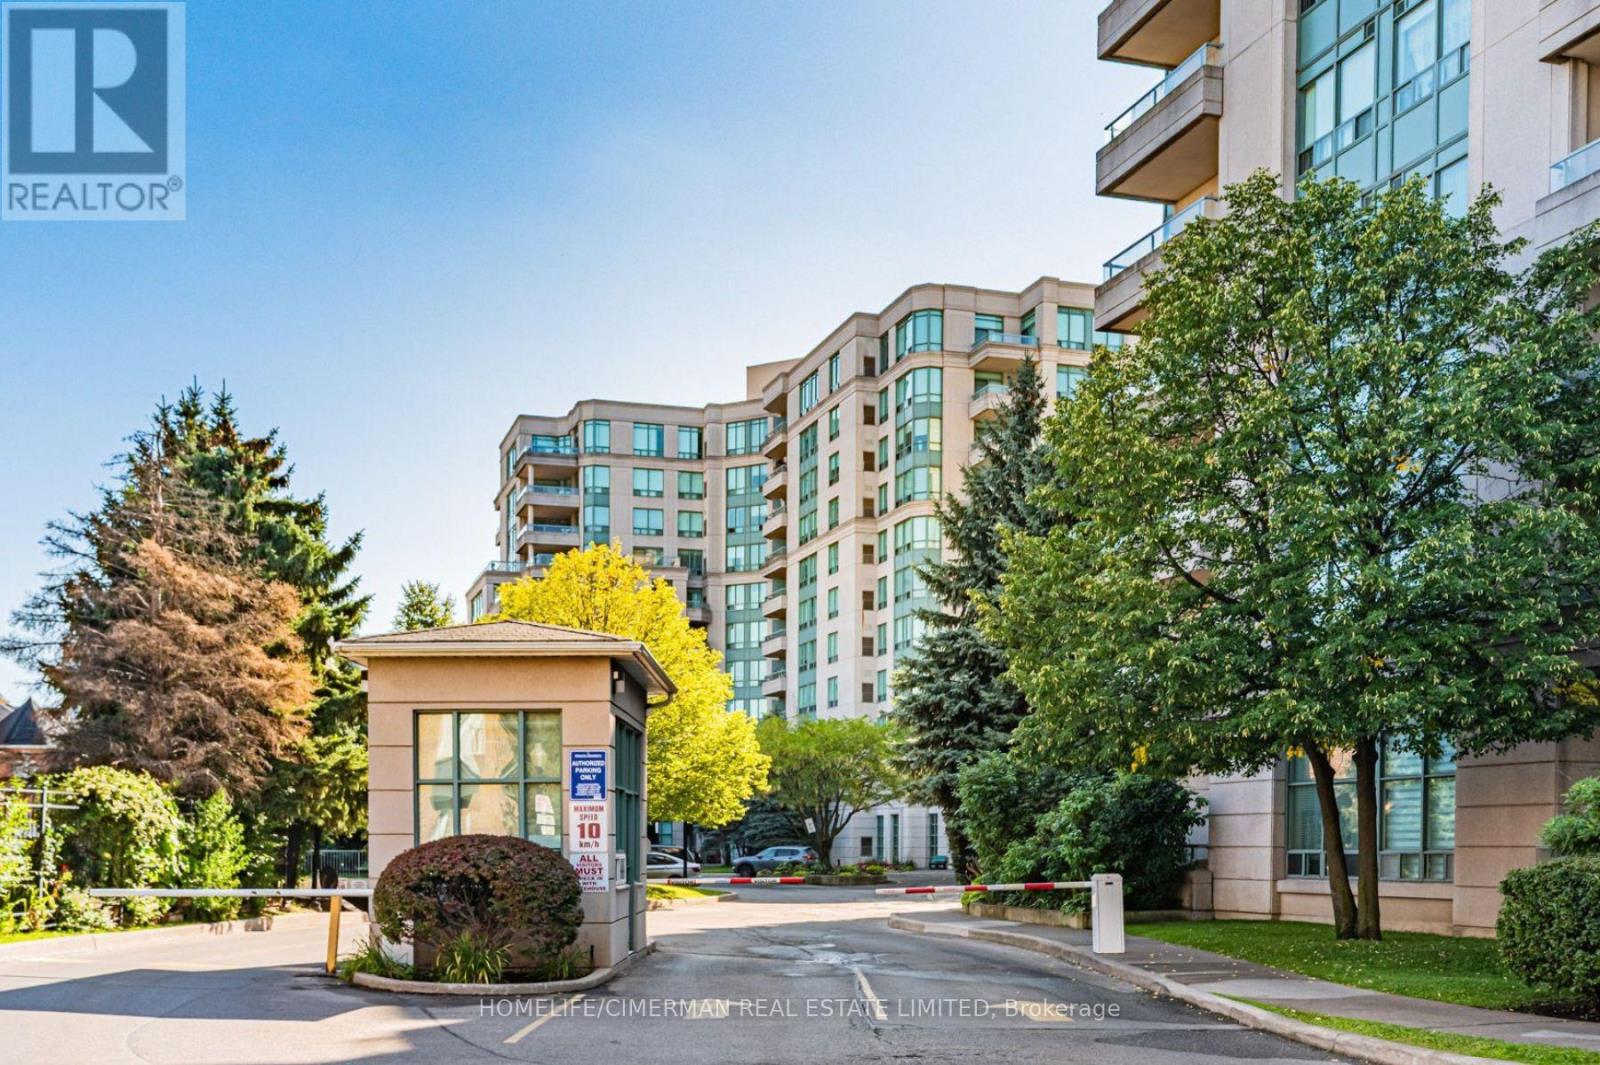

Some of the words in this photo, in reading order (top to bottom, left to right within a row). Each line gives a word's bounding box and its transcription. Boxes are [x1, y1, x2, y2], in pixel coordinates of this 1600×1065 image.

[577, 823, 601, 839] 10
[579, 840, 600, 848] km/h
[580, 854, 598, 862] ALL
[575, 867, 603, 875] MUST
